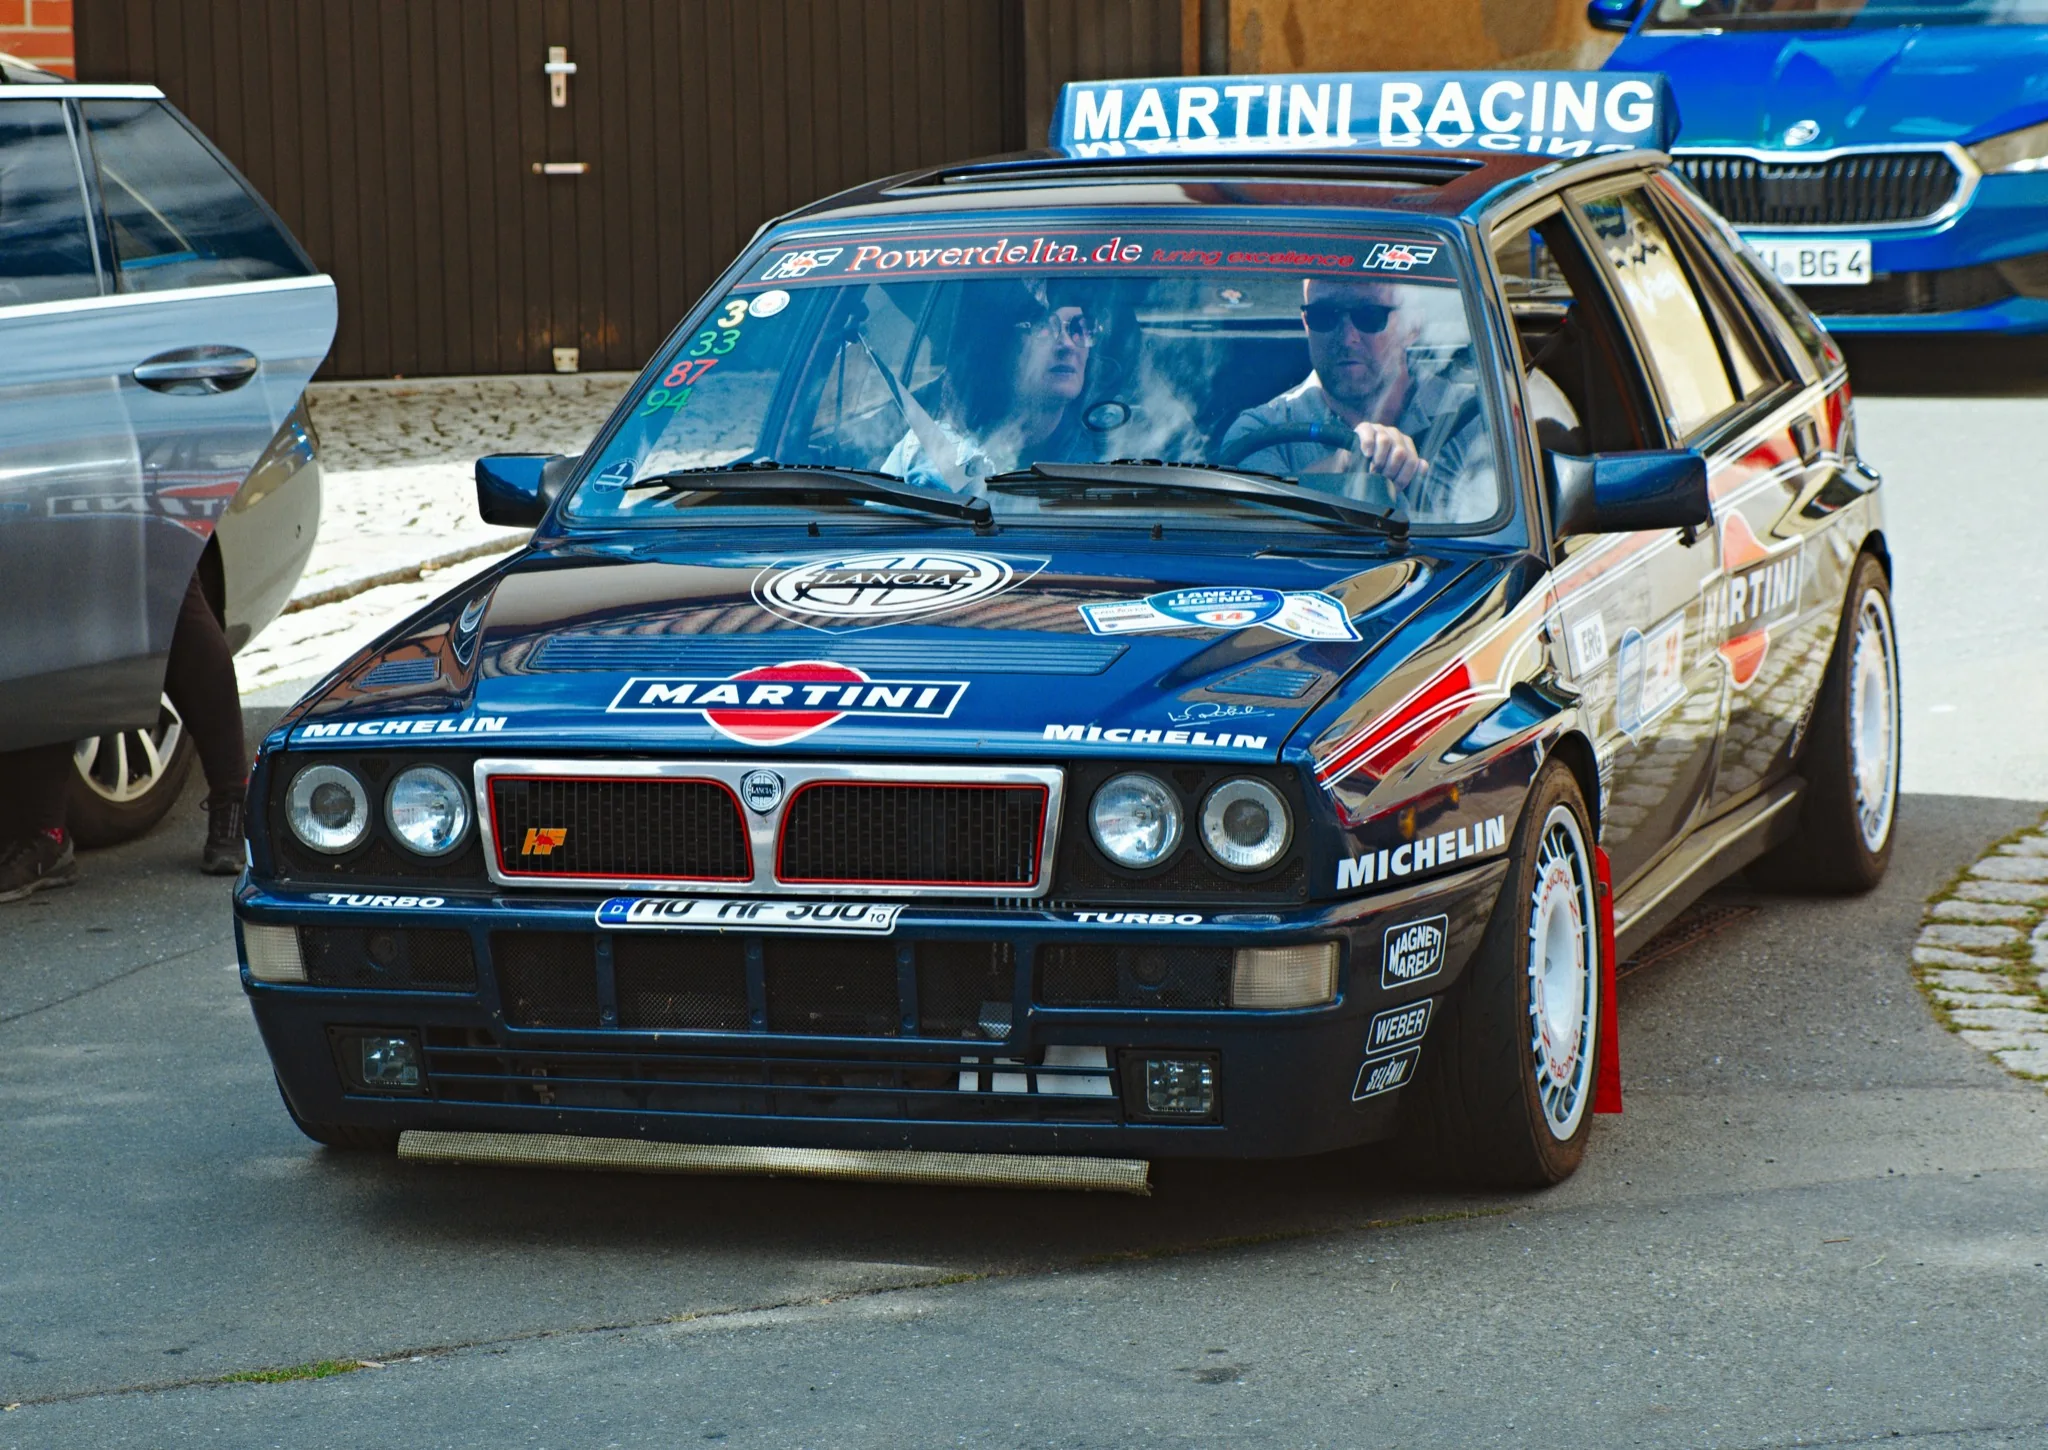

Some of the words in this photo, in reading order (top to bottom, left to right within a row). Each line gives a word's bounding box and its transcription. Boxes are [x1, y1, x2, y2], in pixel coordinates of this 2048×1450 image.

[1073, 83, 1353, 140] MARTINI
[1378, 80, 1655, 133] RACING
[844, 237, 1143, 272] Powerdelta.de
[1151, 248, 1223, 266] tuning
[1227, 249, 1355, 268] excellence
[717, 299, 748, 328] 3
[689, 329, 741, 357] 33
[663, 358, 719, 387] 87
[640, 387, 692, 417] 94
[814, 571, 953, 586] LANCIA
[1168, 594, 1265, 606] LEGENDS
[1176, 589, 1254, 600] LANCIA
[1210, 612, 1243, 622] 14
[638, 683, 941, 709] MARTINI
[301, 716, 508, 738] MICHELIN
[1042, 724, 1269, 749] MICHELIN
[1336, 815, 1506, 890] MICHELIN
[327, 893, 445, 908] TURBO
[610, 904, 624, 914] D
[1073, 911, 1203, 925] TURBO
[1375, 1008, 1425, 1045] WEBER
